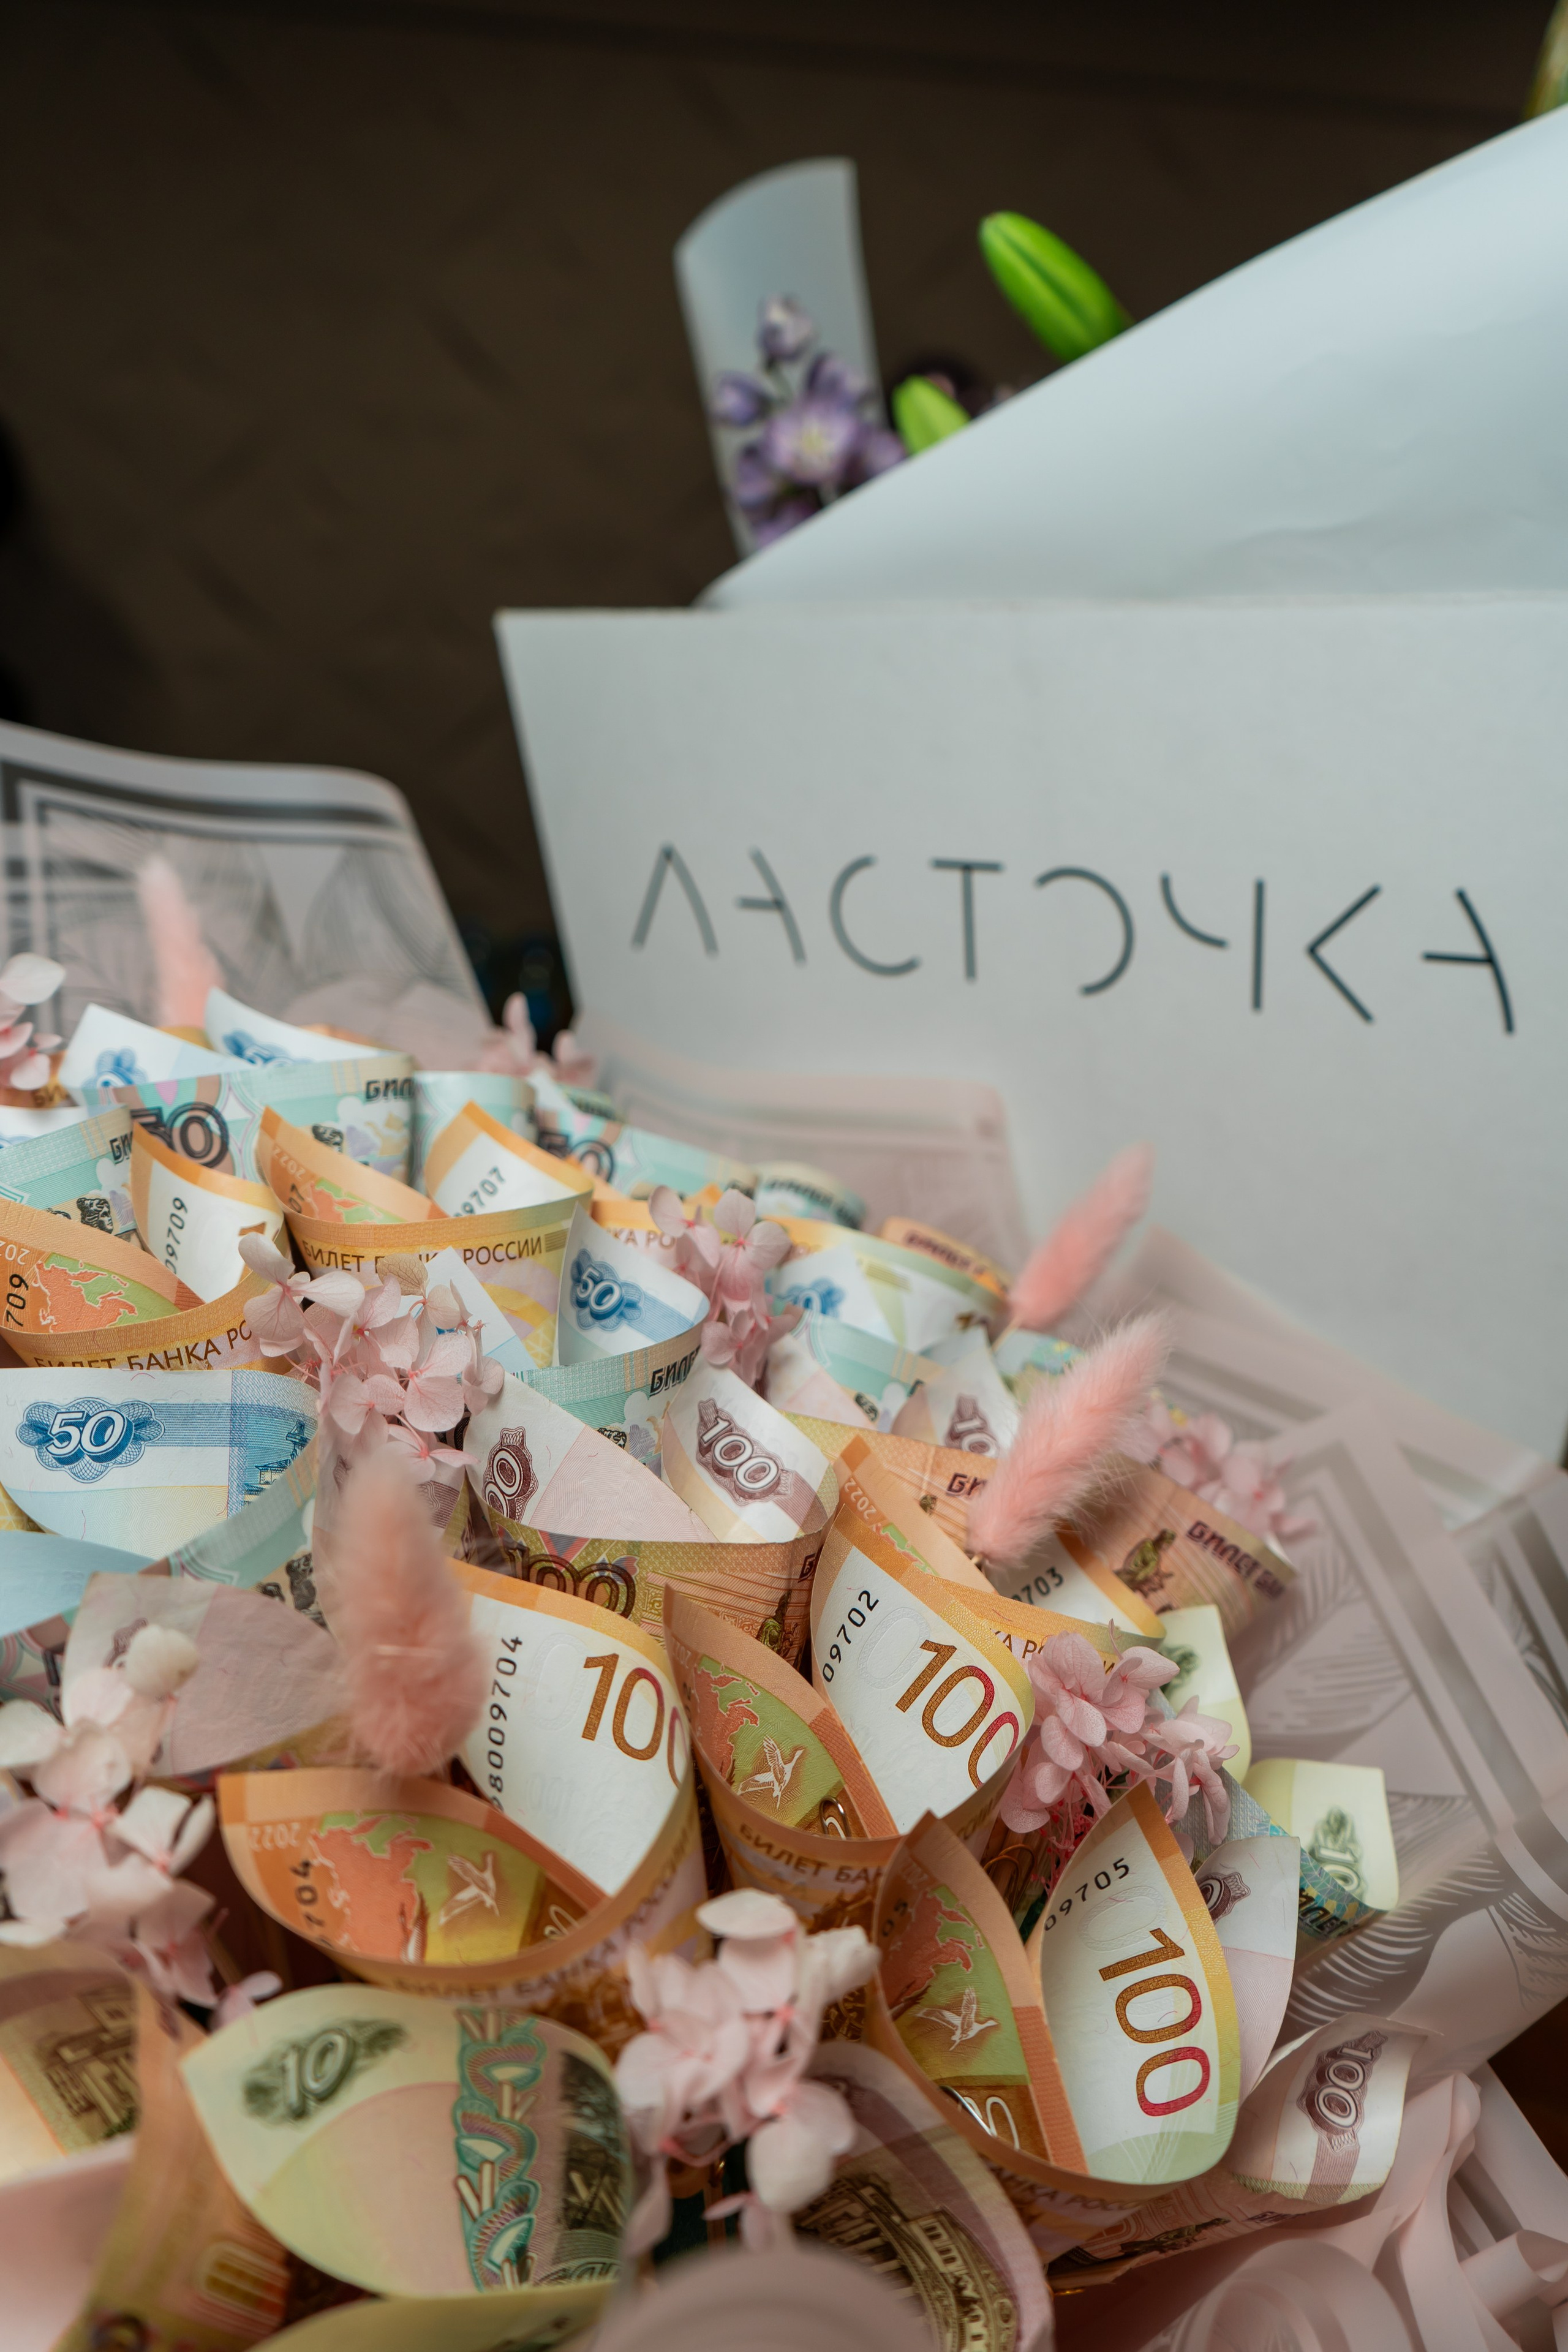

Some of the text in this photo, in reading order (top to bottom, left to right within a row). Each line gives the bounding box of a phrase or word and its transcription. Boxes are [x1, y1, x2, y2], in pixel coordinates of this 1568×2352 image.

[630, 843, 1519, 1038] ЛАСТОЧКА
[110, 1130, 134, 1165] БИ
[454, 1165, 505, 1218] 9707
[463, 1236, 542, 1266] РОССИИ
[576, 1265, 622, 1317] 50
[127, 1338, 222, 1371] БАНКА
[45, 1409, 129, 1461] 50
[699, 1414, 782, 1496] 100
[844, 1476, 877, 1521] 2022
[822, 1589, 879, 1683] 09702
[895, 1639, 1019, 1790] 100
[739, 1823, 829, 1877] БИЛЕТ
[1043, 1857, 1131, 1932] 09705
[1099, 1928, 1210, 2117] 100
[279, 2028, 353, 2119] 10
[1314, 2046, 1376, 2128] 100
